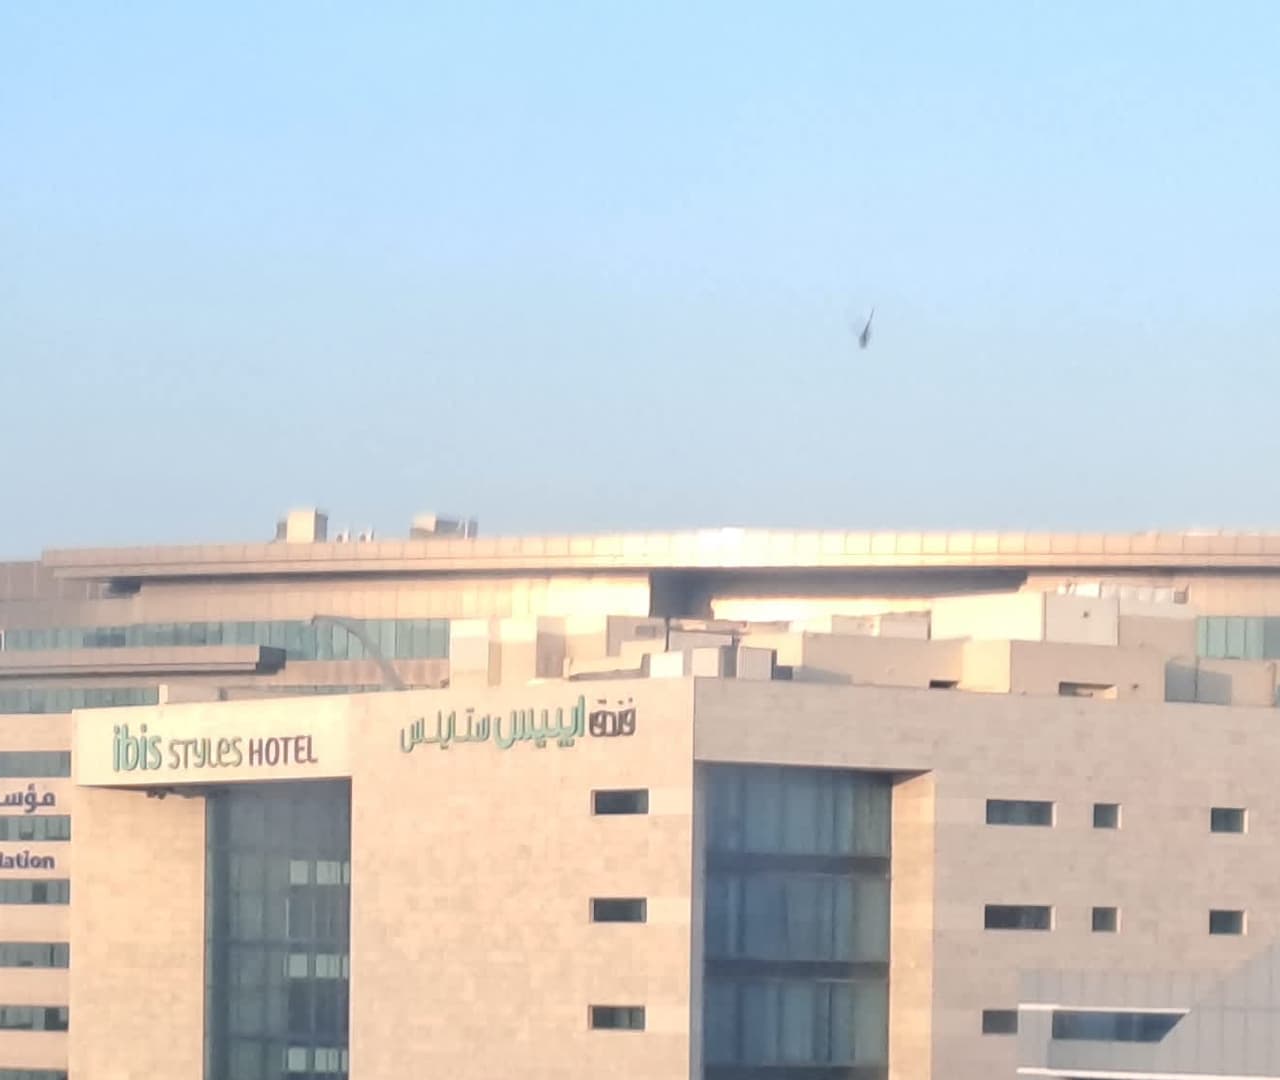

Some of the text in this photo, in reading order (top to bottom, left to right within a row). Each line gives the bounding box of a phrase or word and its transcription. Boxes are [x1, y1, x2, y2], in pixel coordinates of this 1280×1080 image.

[589, 697, 637, 737] فندق
[113, 722, 163, 772] ibis
[249, 734, 320, 767] HOTEL
